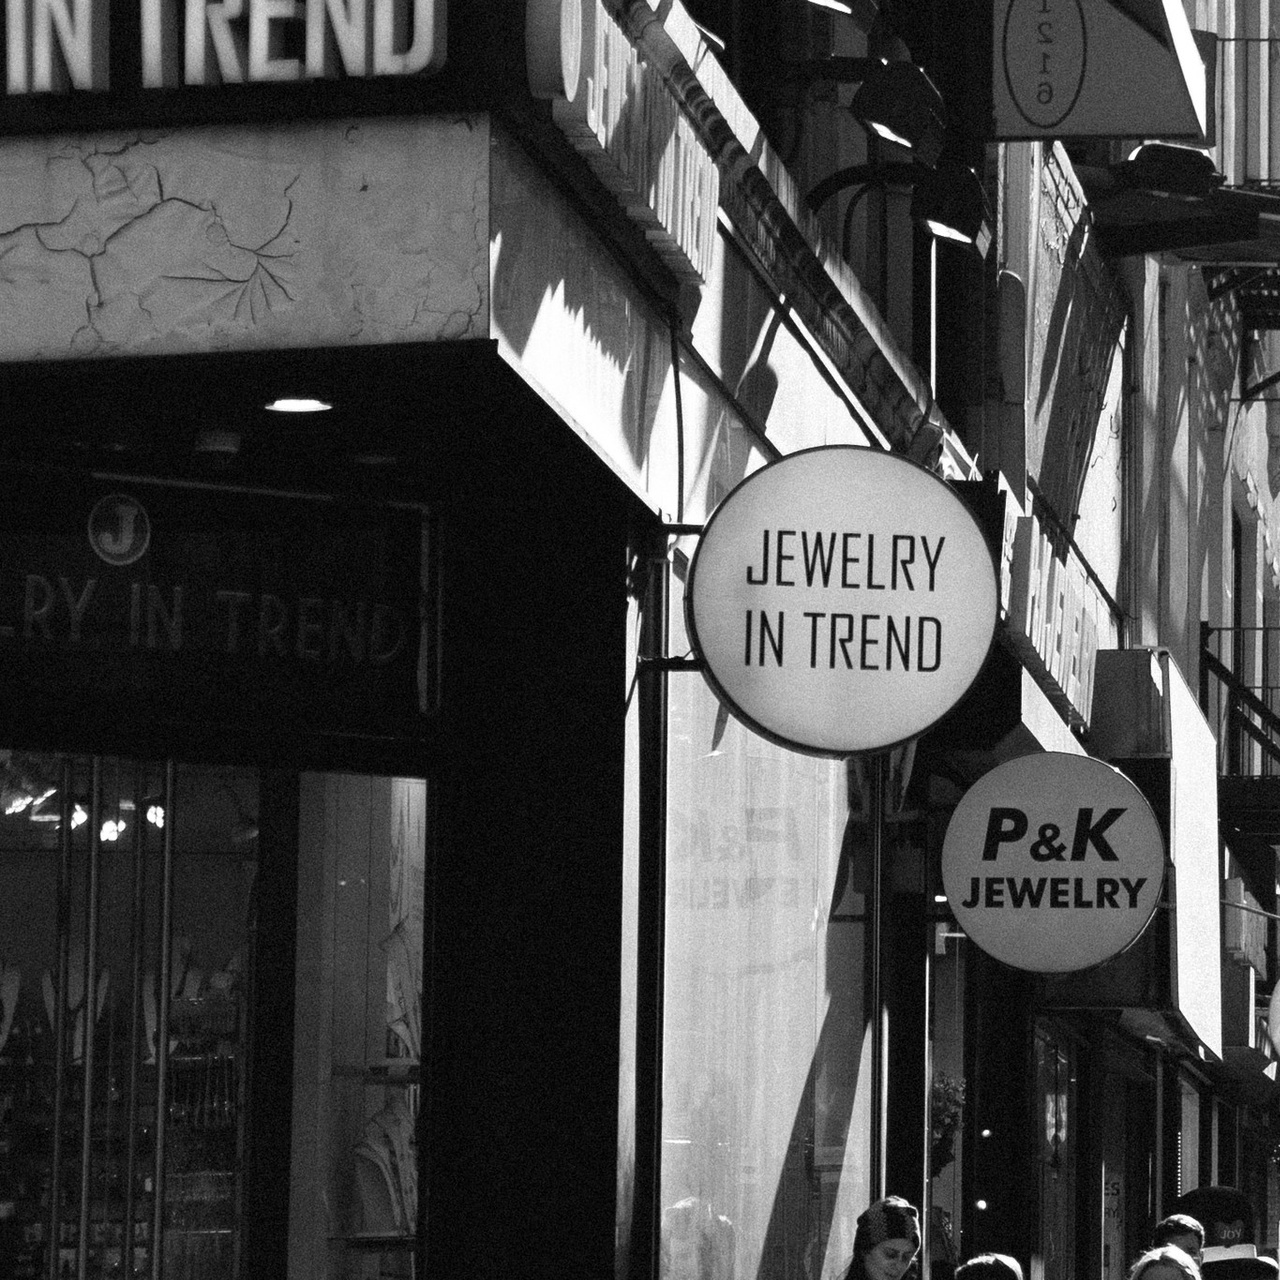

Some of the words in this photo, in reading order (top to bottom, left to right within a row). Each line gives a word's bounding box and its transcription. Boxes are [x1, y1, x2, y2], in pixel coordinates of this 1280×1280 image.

[745, 529, 946, 592] JEWELRY
[130, 581, 183, 650] IN
[216, 588, 407, 664] TREND
[744, 608, 785, 668] IN
[803, 611, 942, 673] TREND
[981, 806, 1129, 862] P&K
[961, 877, 1148, 910] JEWELRY
